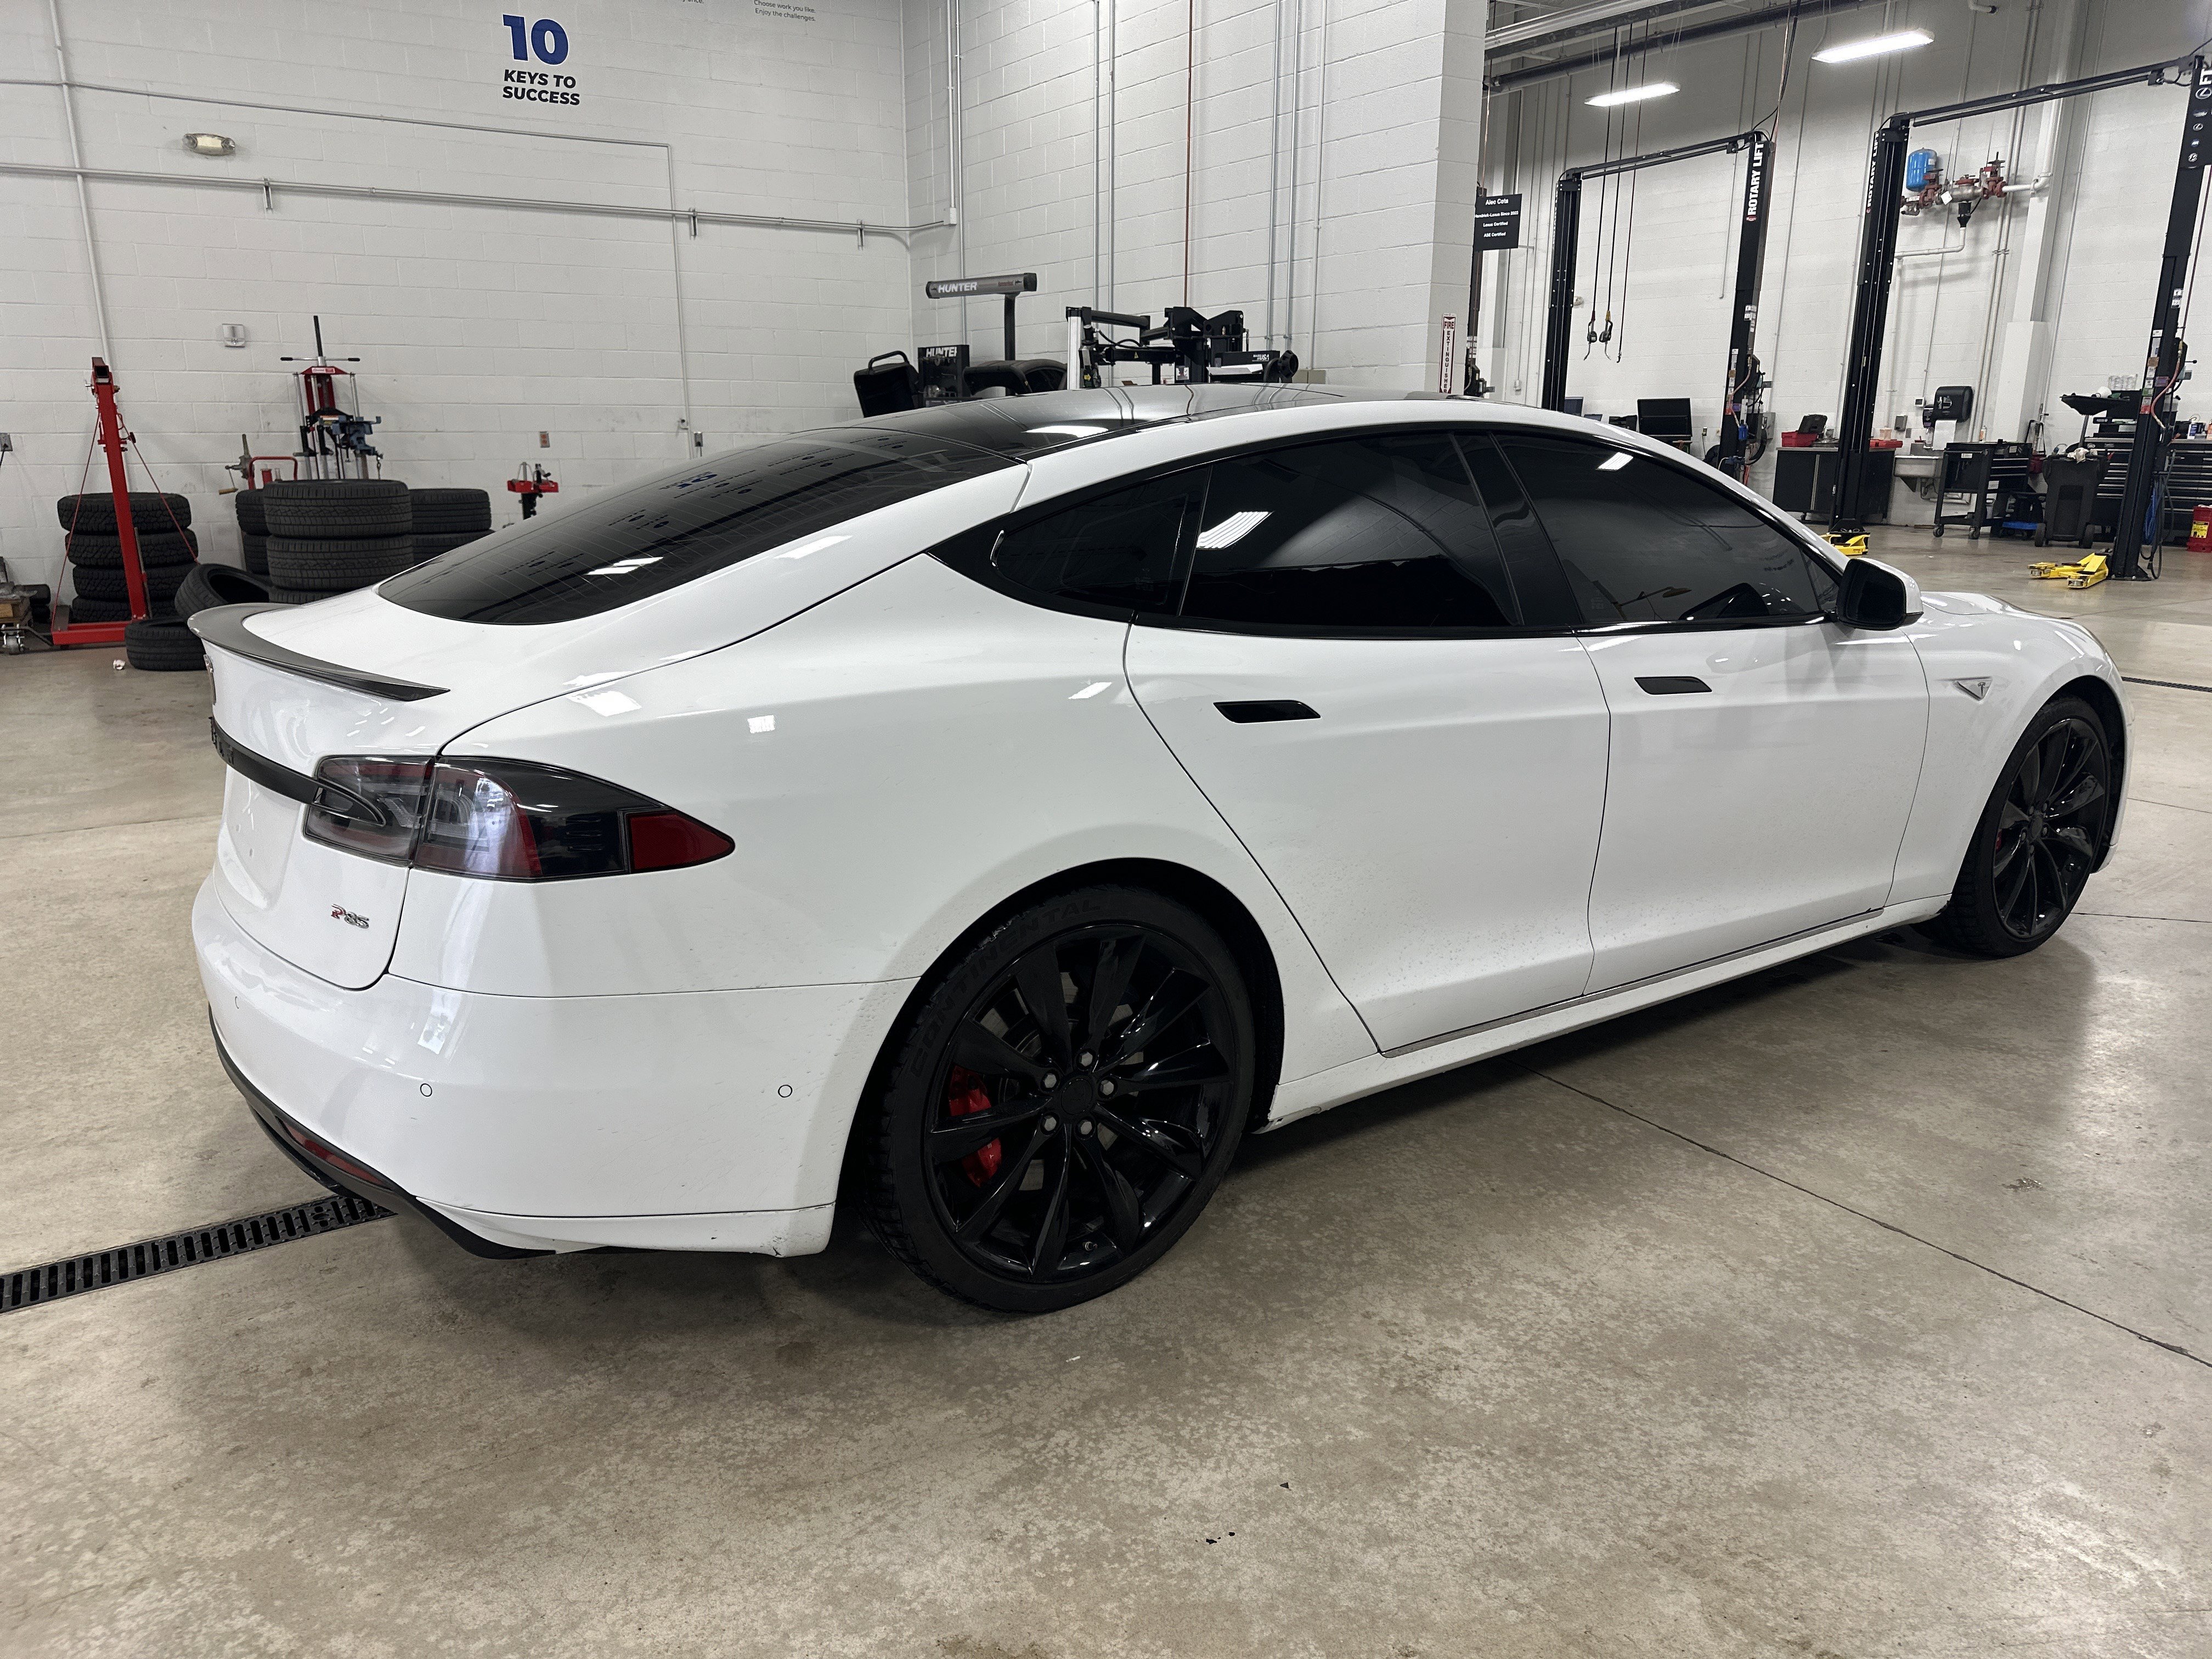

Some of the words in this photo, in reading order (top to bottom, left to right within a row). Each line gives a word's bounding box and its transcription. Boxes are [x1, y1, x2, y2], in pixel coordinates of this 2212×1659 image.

[755, 8, 771, 16] Enjoy
[783, 13, 816, 21] challenges.
[503, 14, 569, 65] 10
[504, 69, 549, 86] KEYS
[553, 75, 576, 88] TO
[503, 86, 580, 105] SUCCESS
[1753, 143, 1764, 167] LIFT
[1747, 170, 1760, 215] ROTARY
[938, 281, 978, 294] HUNTER
[1444, 321, 1454, 329] FIRE
[330, 904, 369, 929] P85
[910, 899, 1101, 1077] CONTINENTAL
